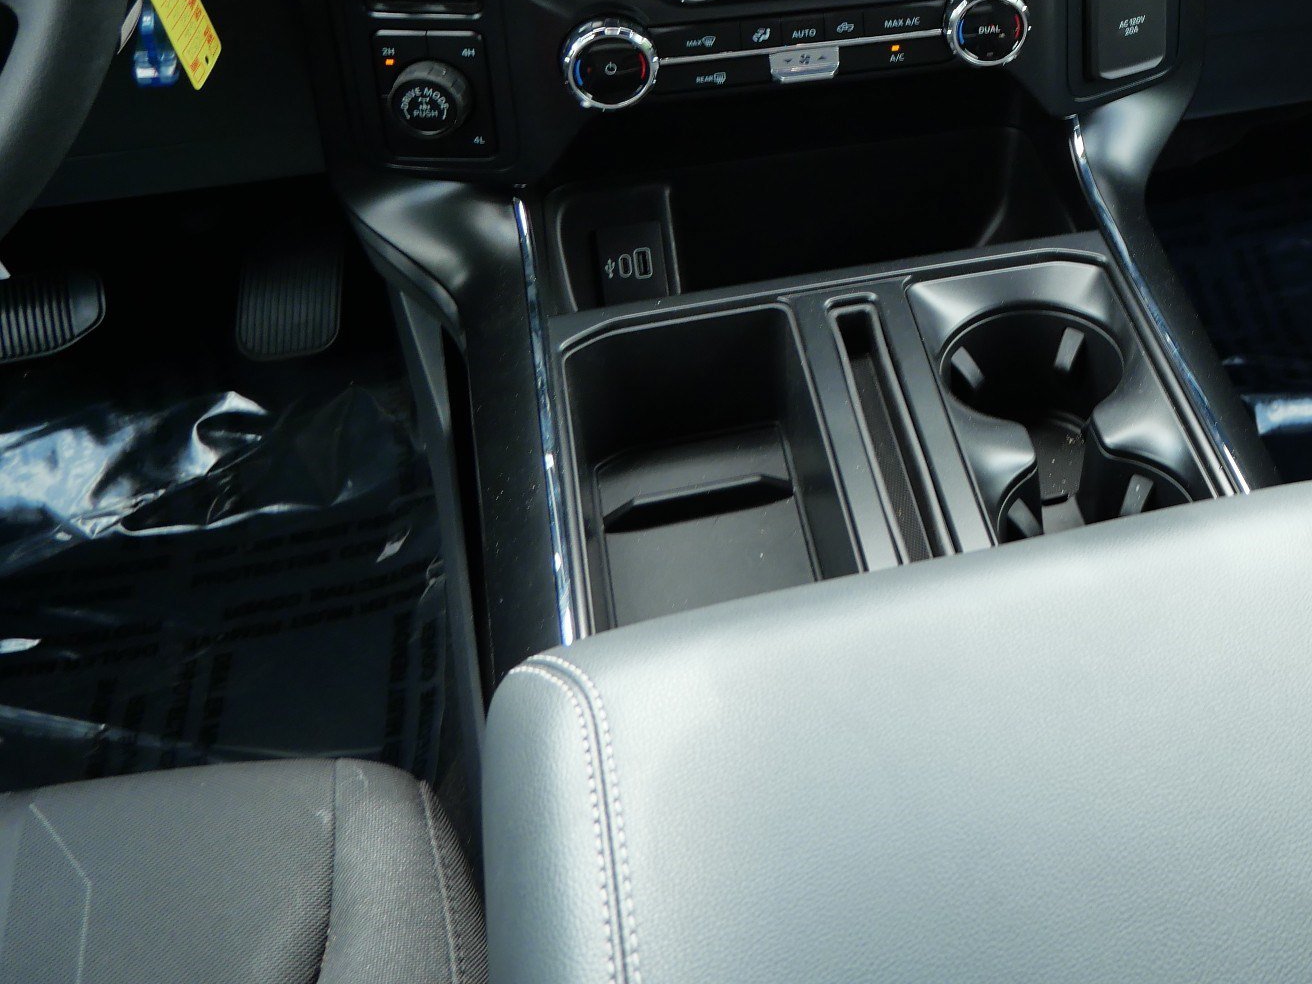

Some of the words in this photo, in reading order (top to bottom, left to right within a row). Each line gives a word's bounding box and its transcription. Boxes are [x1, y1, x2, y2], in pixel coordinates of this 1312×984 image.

[884, 19, 904, 28] MAX
[905, 17, 921, 27] A/C
[792, 29, 817, 39] AUTO
[978, 24, 1001, 34] DUAL
[382, 47, 395, 56] 2H
[889, 52, 905, 63] A/C
